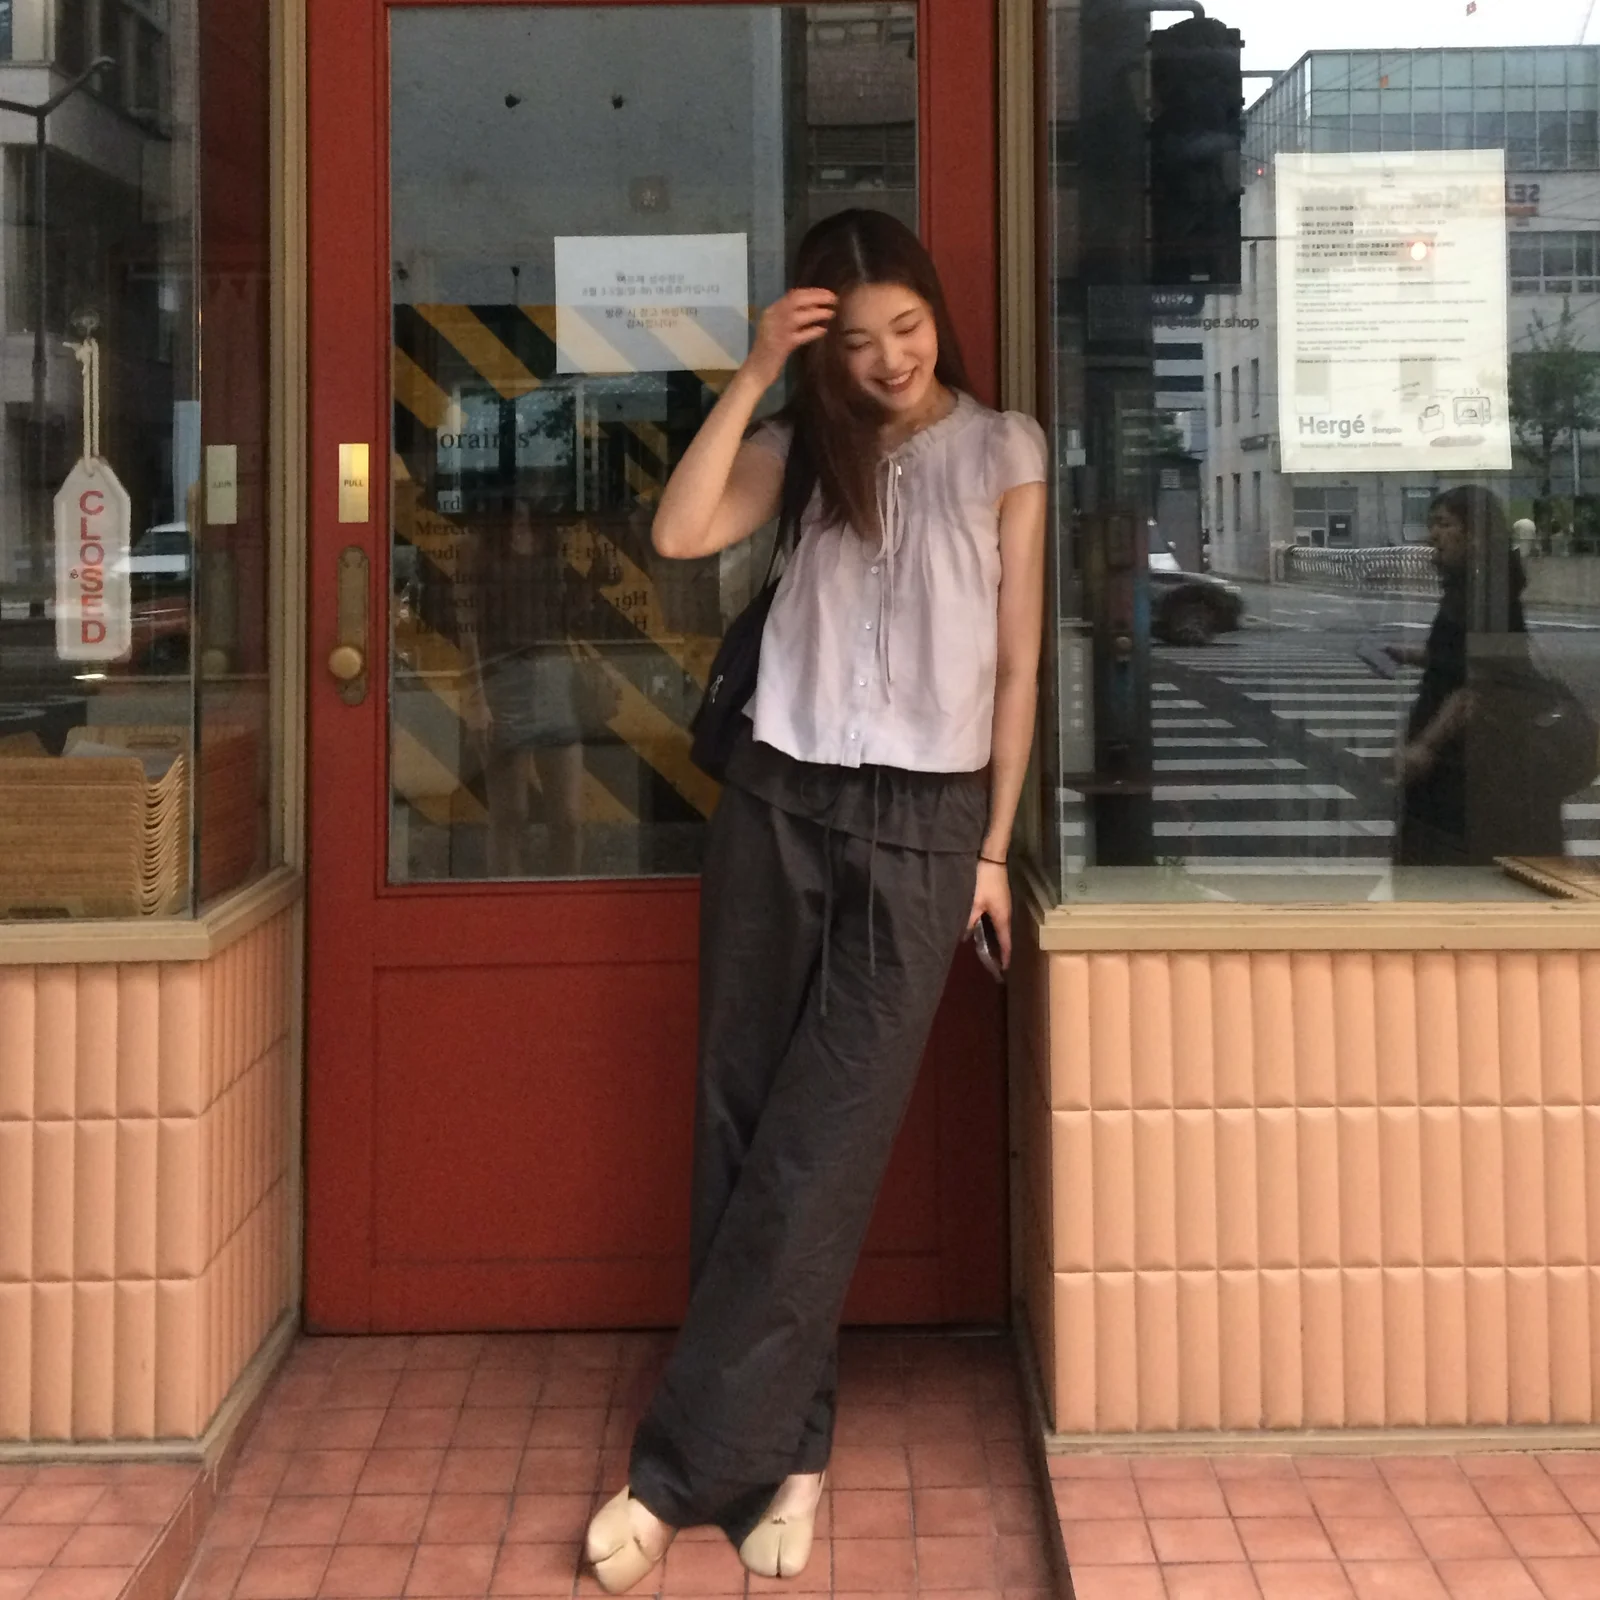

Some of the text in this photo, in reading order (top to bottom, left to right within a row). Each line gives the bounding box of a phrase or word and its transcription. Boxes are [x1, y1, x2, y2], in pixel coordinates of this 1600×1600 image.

[1298, 414, 1365, 438] Hergé
[343, 479, 364, 487] PULL
[79, 490, 107, 644] CLOSED
[615, 591, 648, 611] 19H
